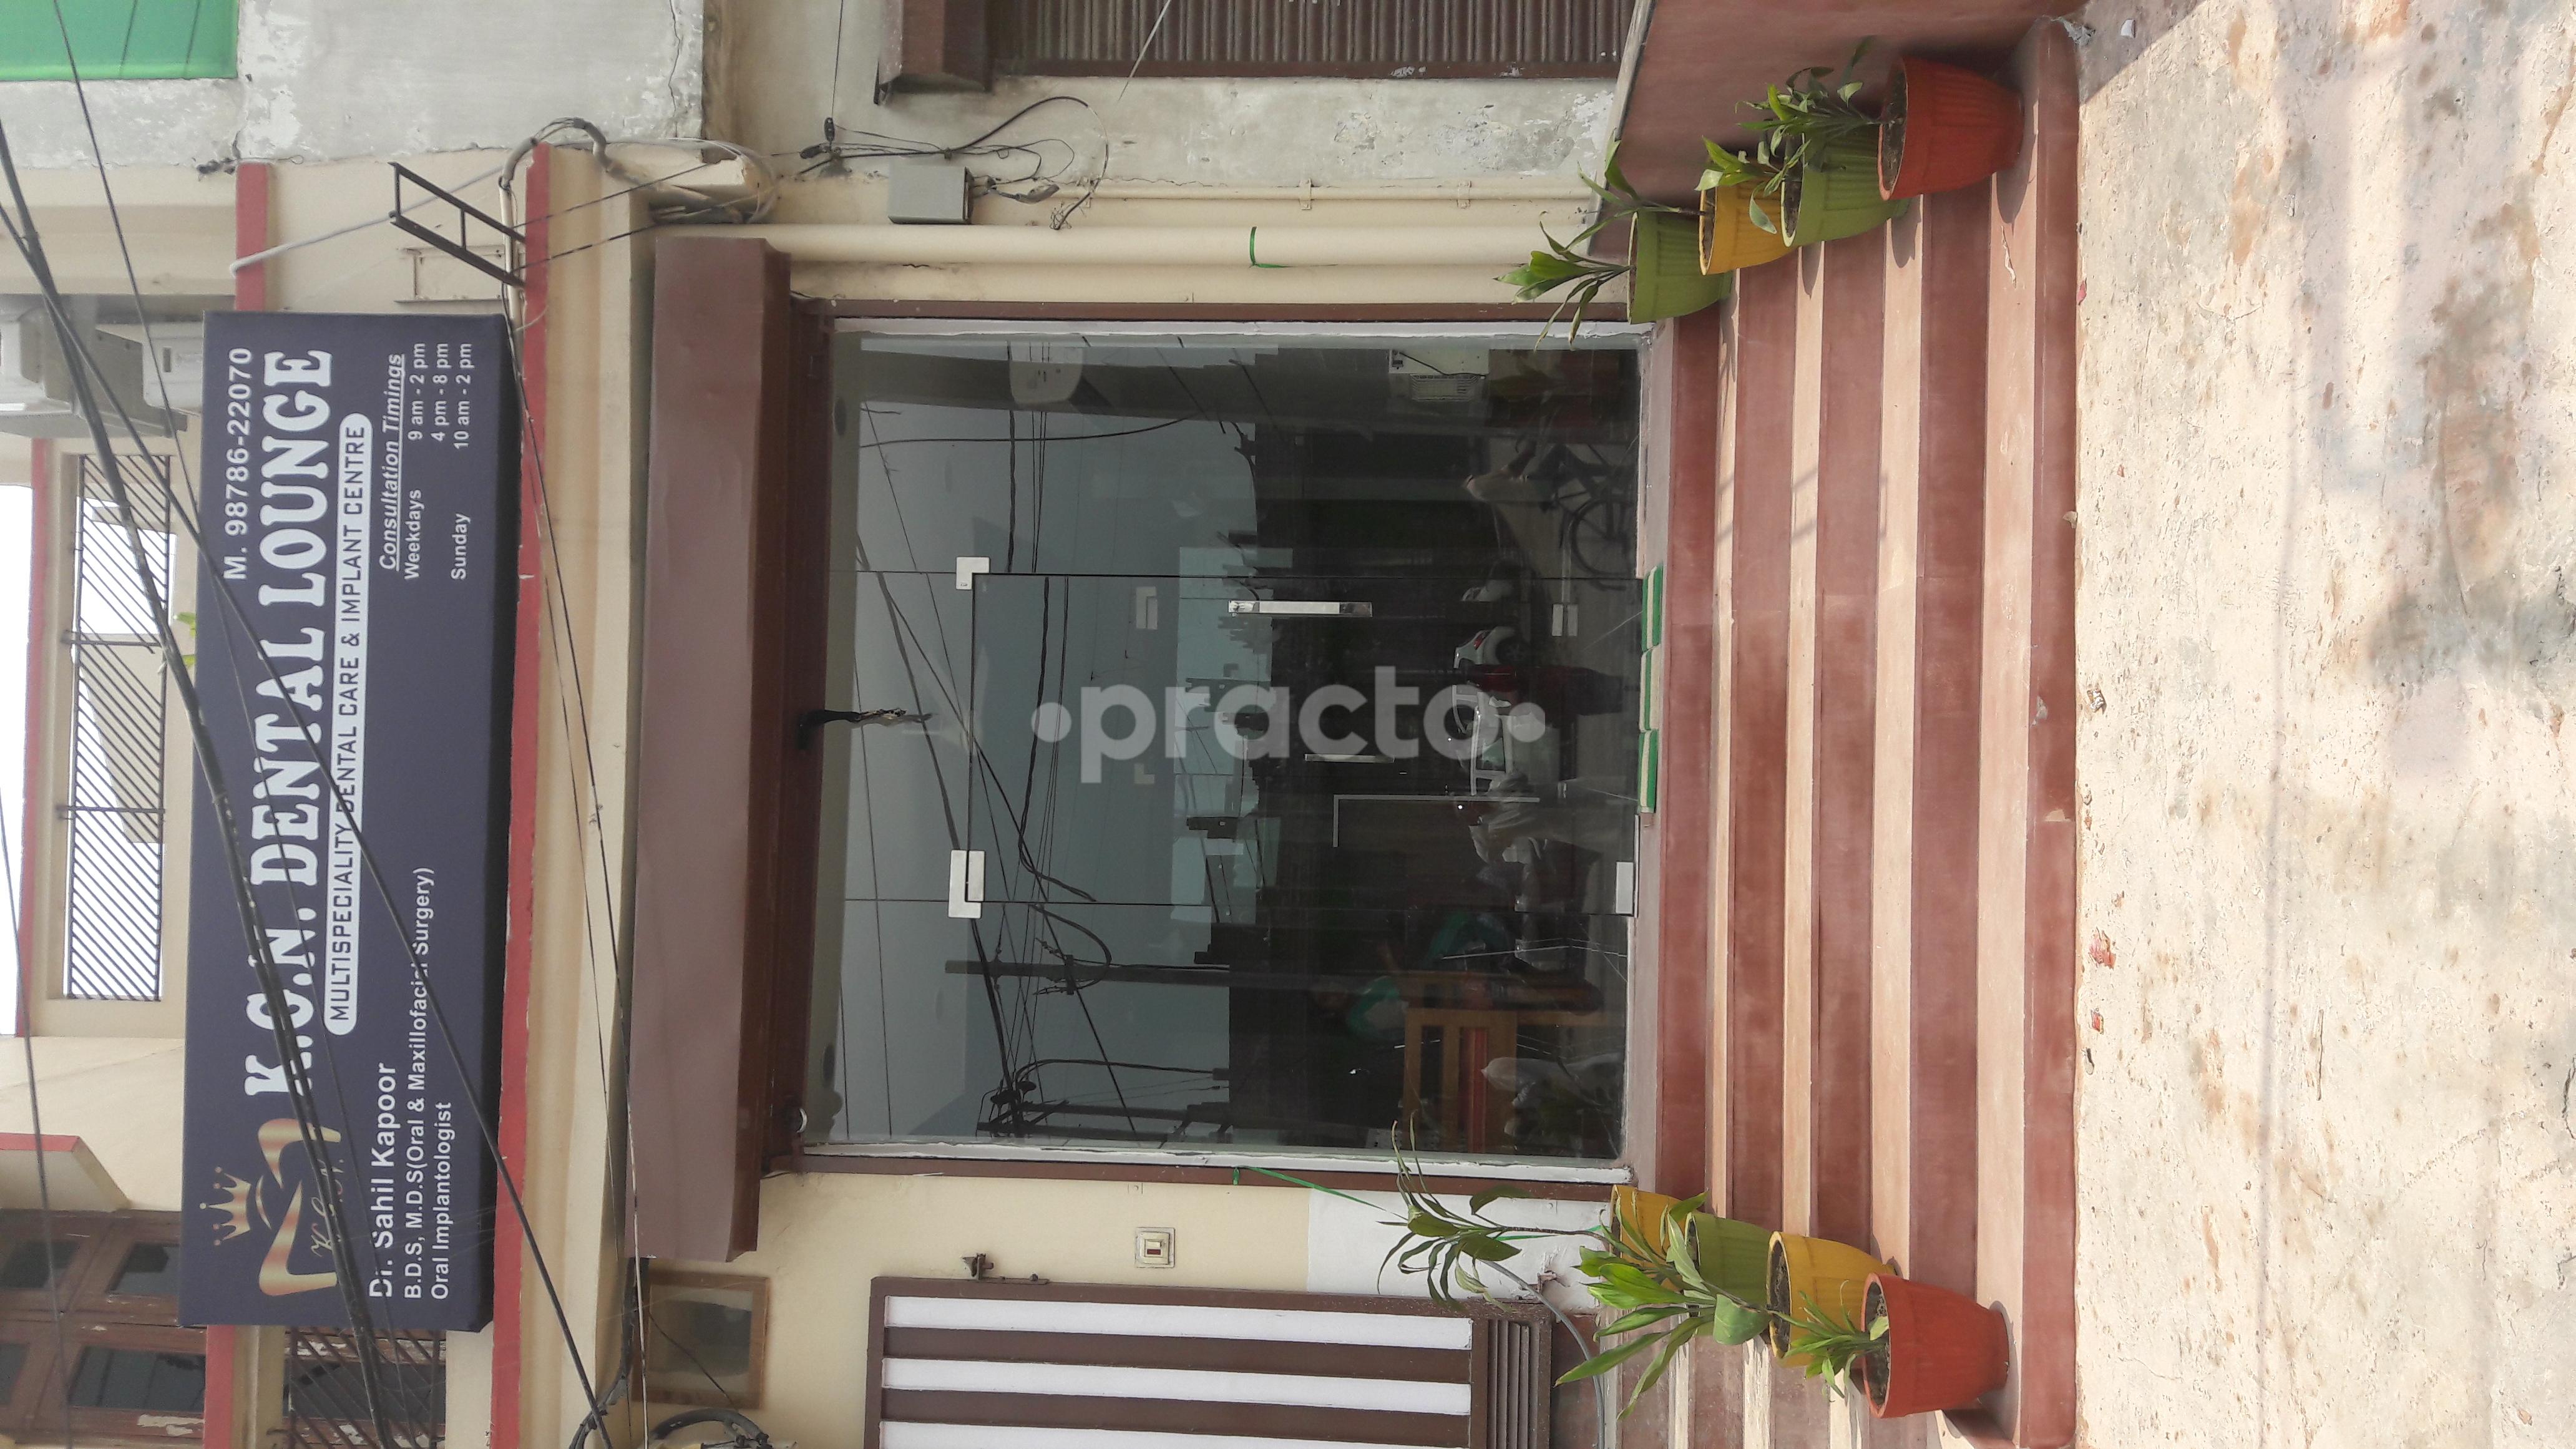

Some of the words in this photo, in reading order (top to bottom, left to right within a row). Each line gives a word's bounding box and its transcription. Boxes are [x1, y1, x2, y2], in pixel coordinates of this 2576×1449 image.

[409, 374, 424, 384] 2
[413, 343, 428, 369] pm
[432, 374, 448, 384] 8
[436, 343, 452, 368] pm
[456, 374, 471, 384] 2
[459, 343, 475, 369] pm
[381, 354, 404, 432] Timings
[411, 401, 424, 425] am
[434, 401, 449, 426] pm
[457, 401, 470, 425] am
[224, 348, 252, 536] 98786-22070
[407, 431, 423, 440] 9
[431, 431, 446, 442] 4
[453, 431, 469, 449] 10
[258, 350, 332, 607] LOUNGE
[344, 427, 364, 515] CENTRE
[379, 440, 401, 571] Consultation
[404, 489, 425, 580] Weekdays
[223, 547, 247, 580] M.
[341, 525, 362, 622] IMPLANT
[451, 514, 471, 580] Sunday
[341, 633, 359, 646] &
[339, 657, 359, 716] CARE
[250, 627, 325, 886] DENTAL
[336, 726, 357, 813] DENTAL
[329, 823, 354, 1021] MULTISPECIALITY
[412, 868, 434, 955] Surgery)
[407, 963, 427, 1090] Maxillofacial
[371, 1062, 401, 1167] Kapoor
[409, 1098, 425, 1112] &
[432, 1102, 456, 1249] Implantologist
[370, 1178, 394, 1249] Sahil
[369, 1260, 393, 1297] Dr.
[404, 1237, 425, 1298] B.D.S,
[431, 1257, 449, 1299] Oral
